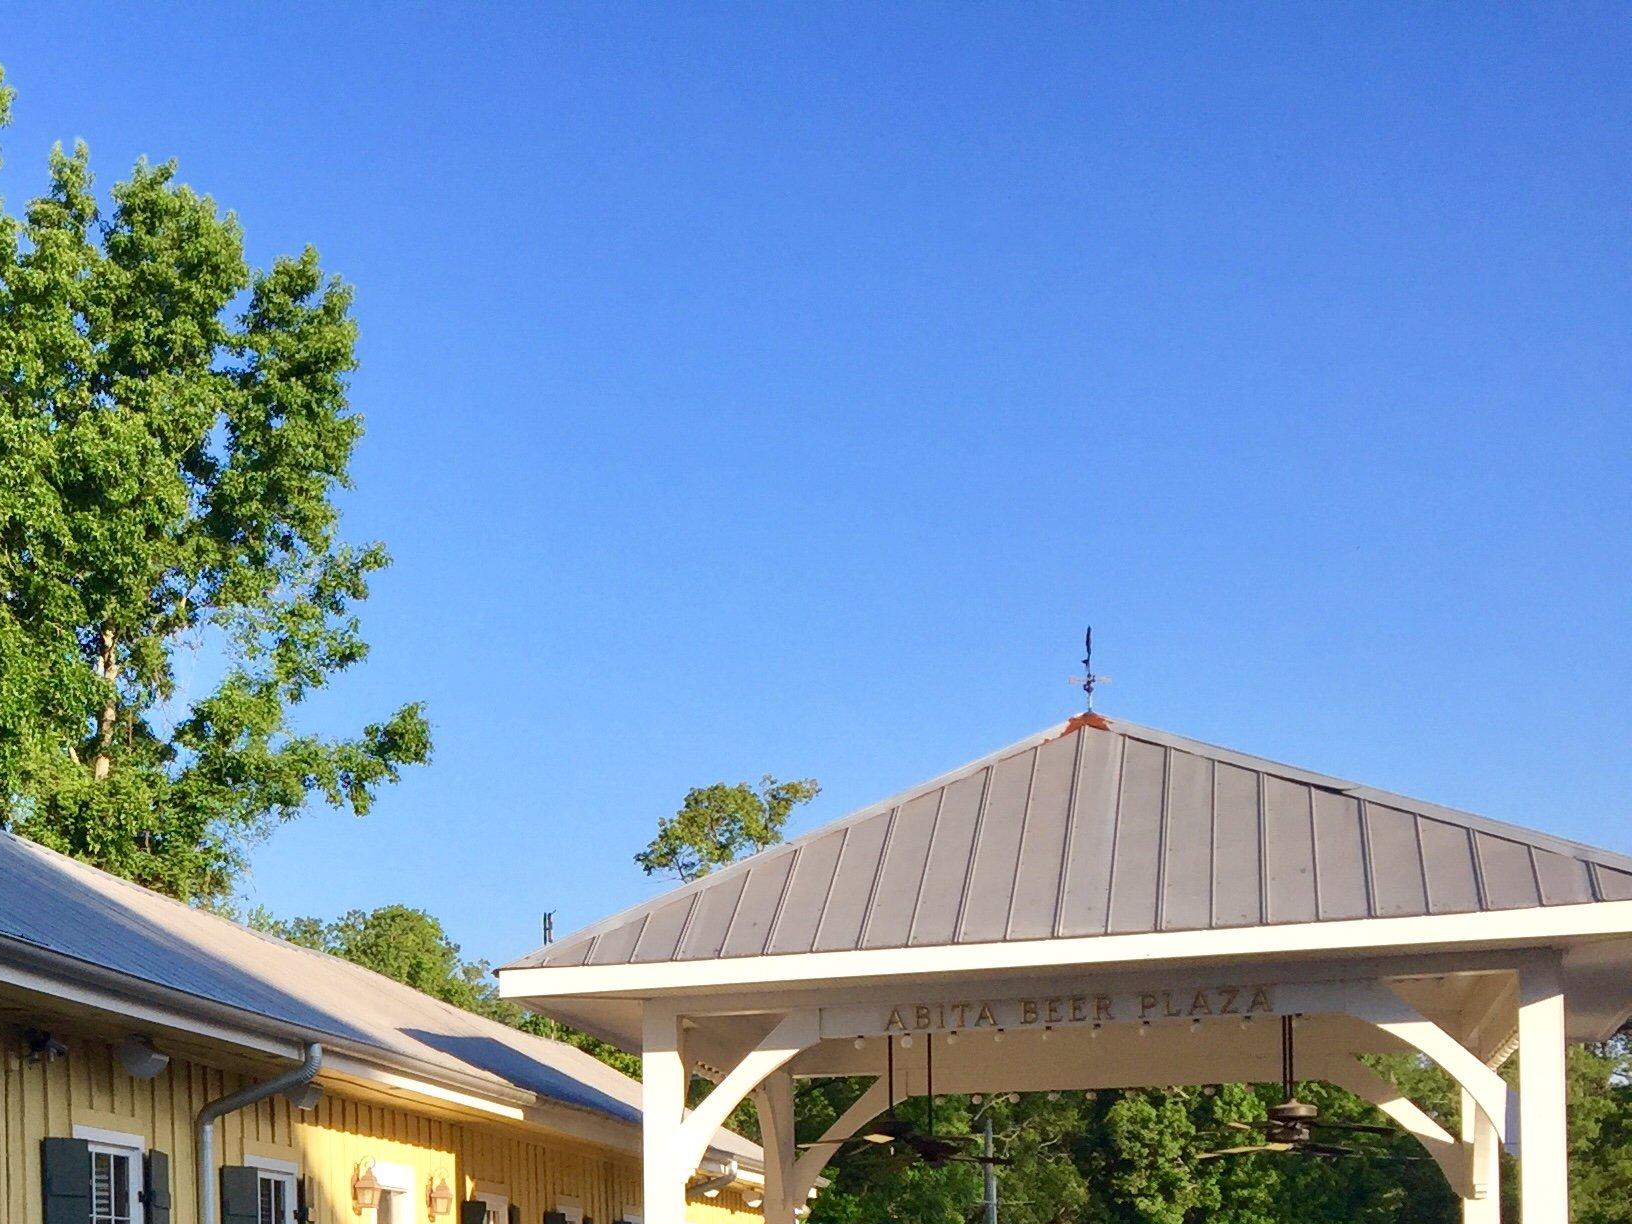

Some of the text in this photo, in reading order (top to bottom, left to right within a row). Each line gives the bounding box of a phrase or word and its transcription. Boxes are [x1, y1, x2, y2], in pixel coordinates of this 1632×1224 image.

[885, 985, 1274, 1031] ABITA BEER PLAZA
